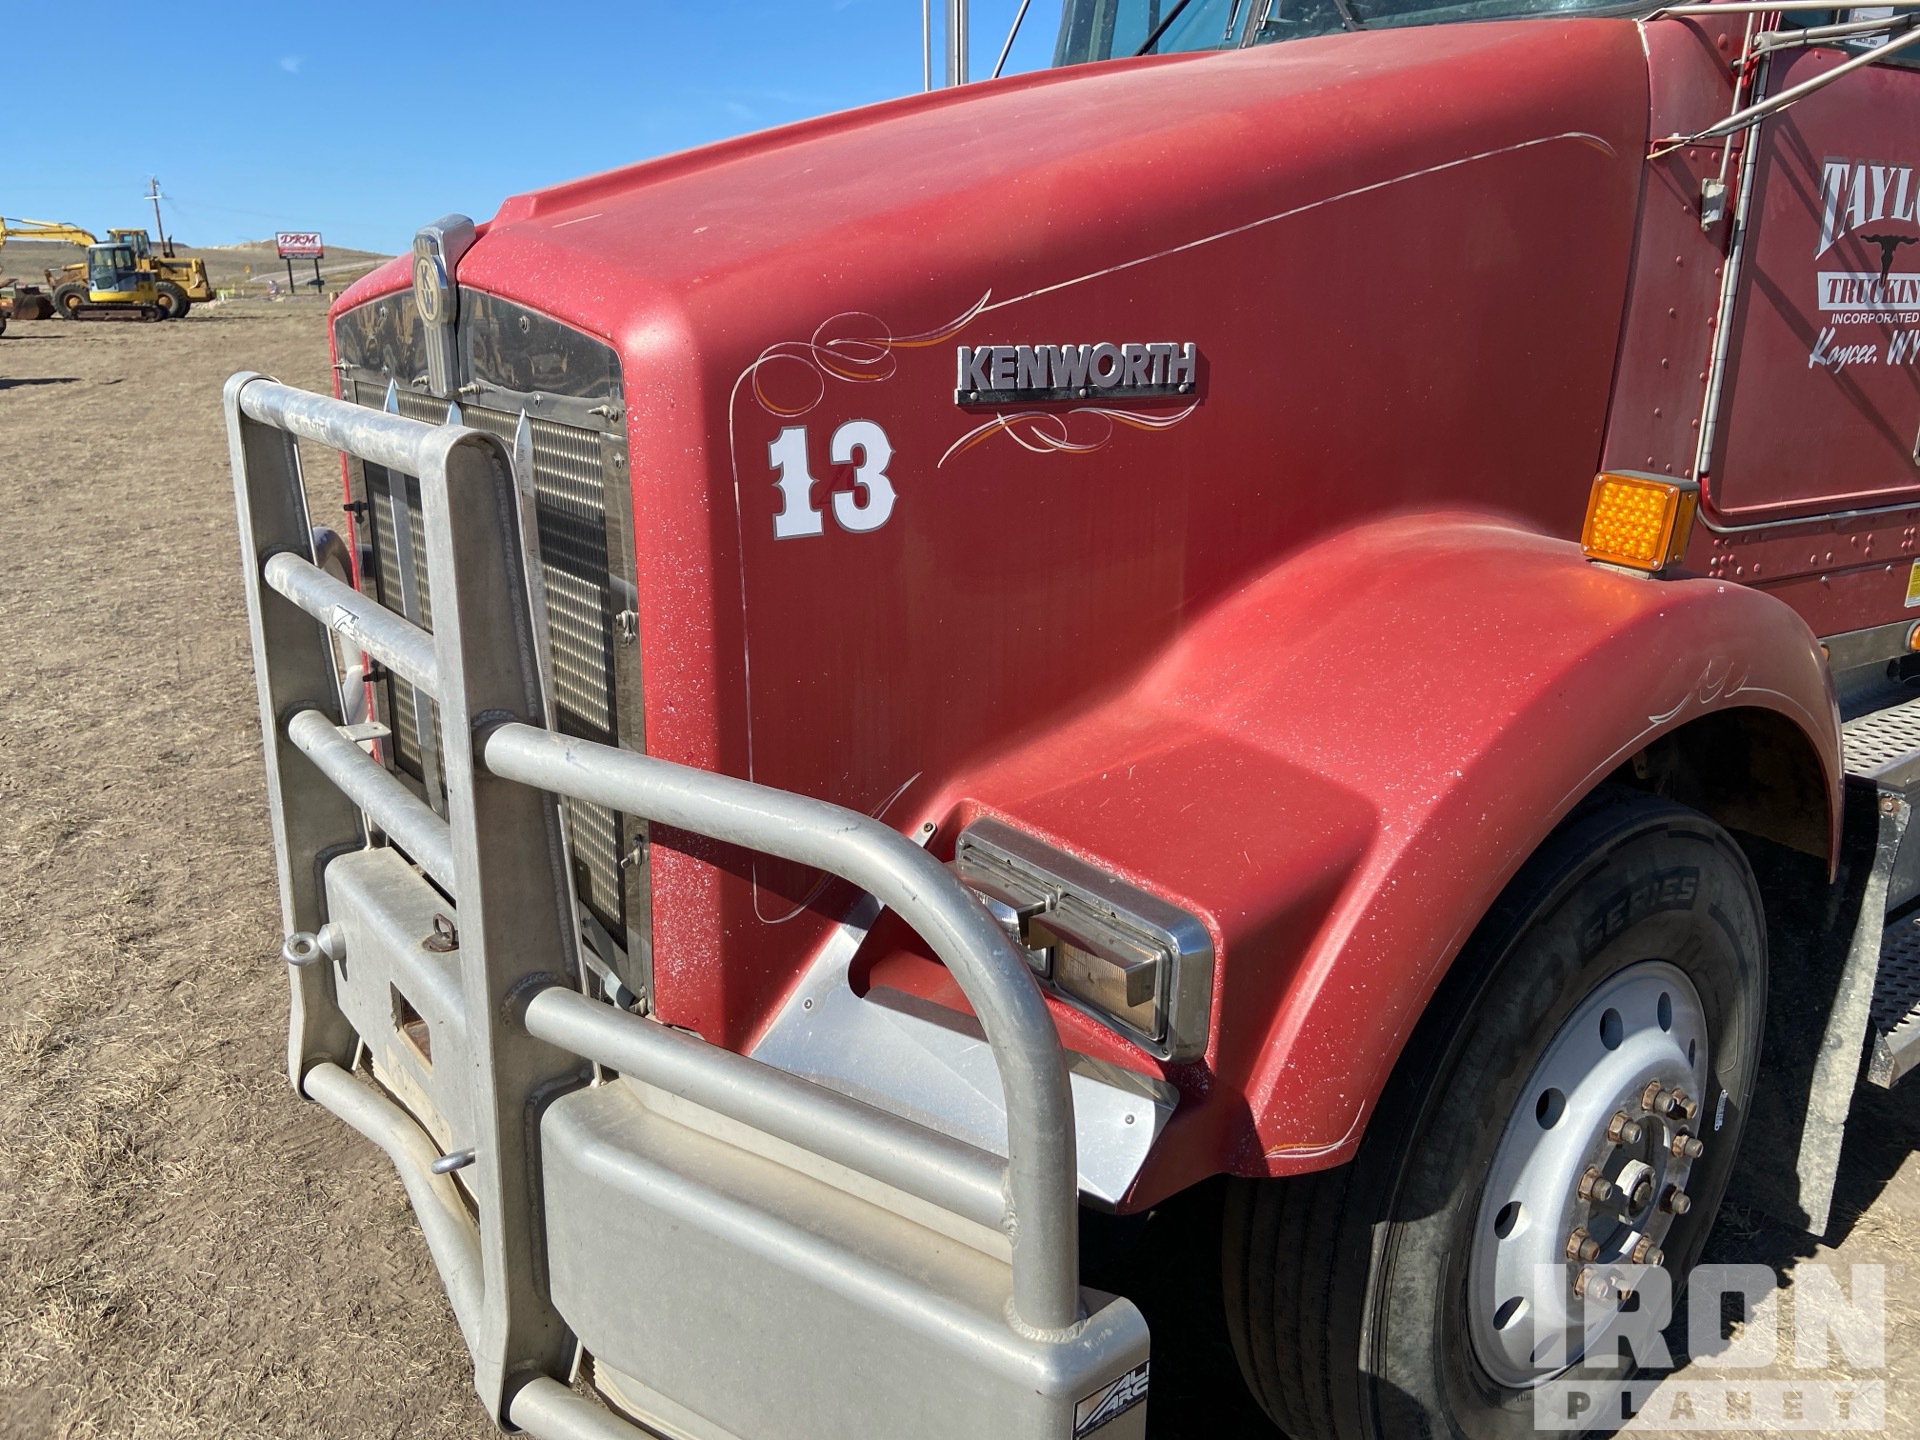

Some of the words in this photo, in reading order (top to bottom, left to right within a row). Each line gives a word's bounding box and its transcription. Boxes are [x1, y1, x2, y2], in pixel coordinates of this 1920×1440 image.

[1814, 157, 1920, 260] TAYL
[1831, 312, 1920, 325] INCORPORATED
[956, 341, 1196, 391] KENWORTH
[767, 418, 899, 540] 13
